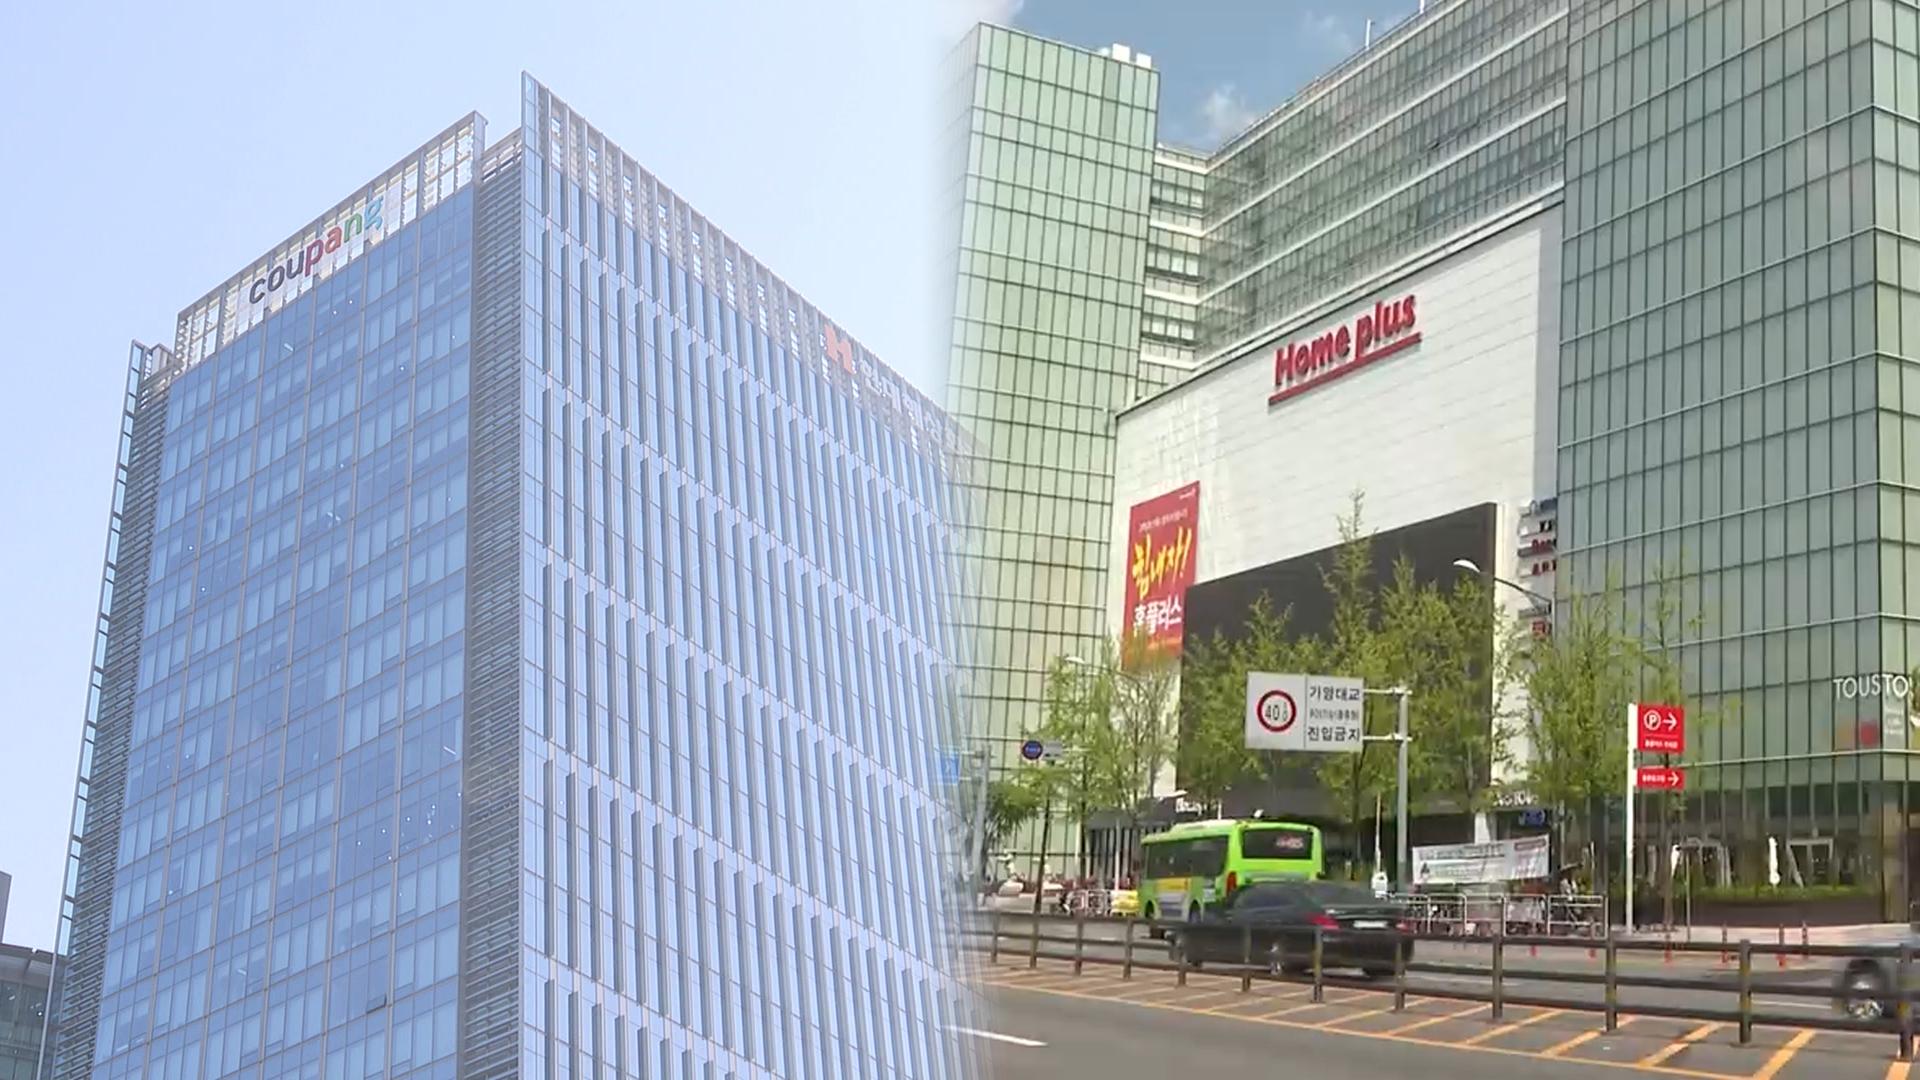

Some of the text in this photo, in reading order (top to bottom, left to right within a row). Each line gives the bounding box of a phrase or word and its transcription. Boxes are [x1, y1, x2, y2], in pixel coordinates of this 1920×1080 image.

[248, 194, 384, 305] coupang
[1274, 293, 1417, 387] Home plus
[1309, 684, 1361, 702] 가양대교
[1832, 673, 1881, 700] TOUS
[1307, 725, 1361, 742] 진입금지
